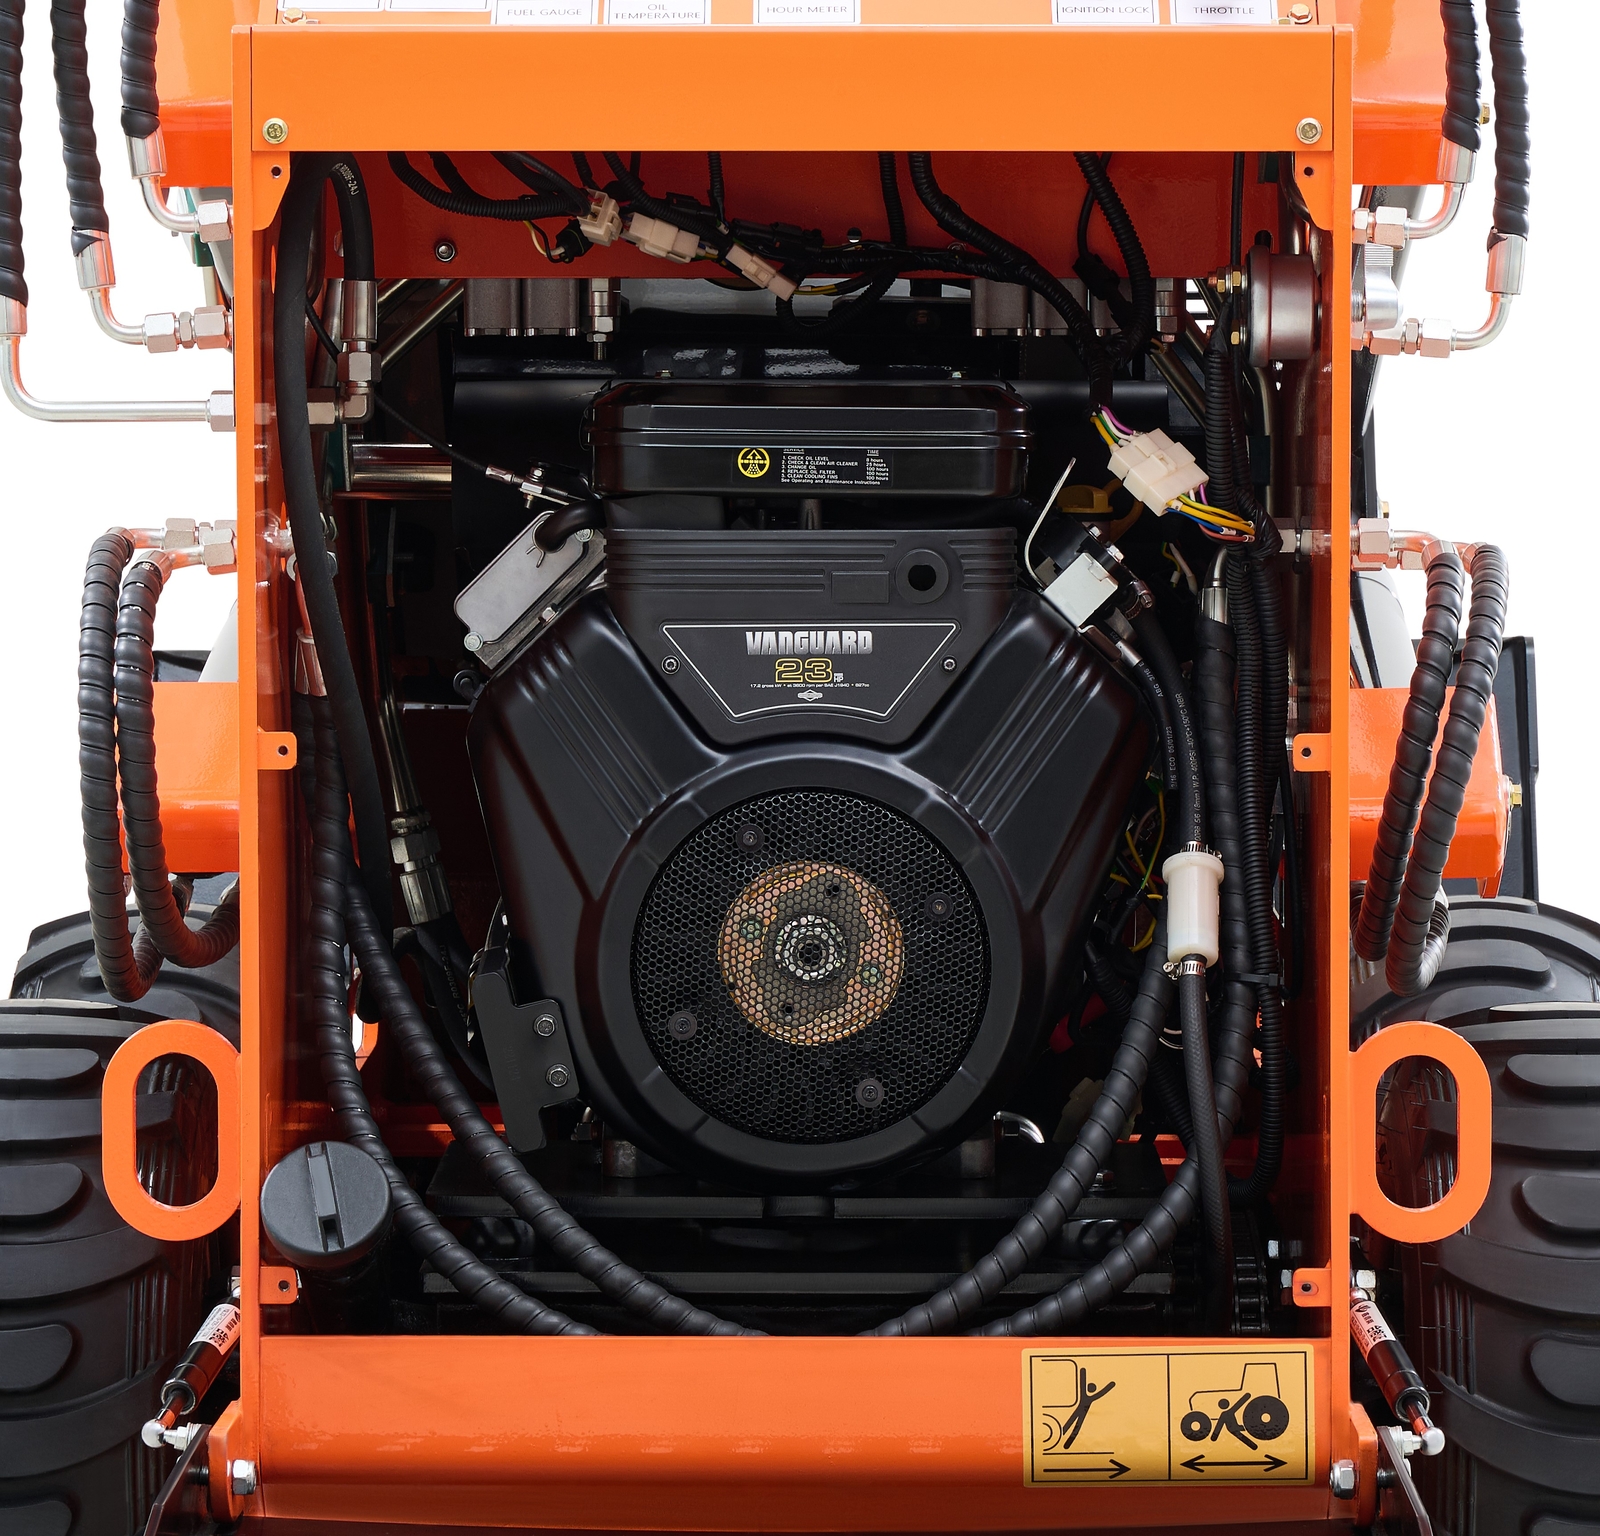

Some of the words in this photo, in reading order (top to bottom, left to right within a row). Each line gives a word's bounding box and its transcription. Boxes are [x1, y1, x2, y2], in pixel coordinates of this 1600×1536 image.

[540, 8, 582, 16] GAUGE
[1193, 6, 1254, 14] THROTTLE
[745, 631, 873, 655] VANGUARD
[775, 658, 832, 682] 23
[1153, 684, 1164, 698] ABG
[1175, 692, 1186, 708] NBR
